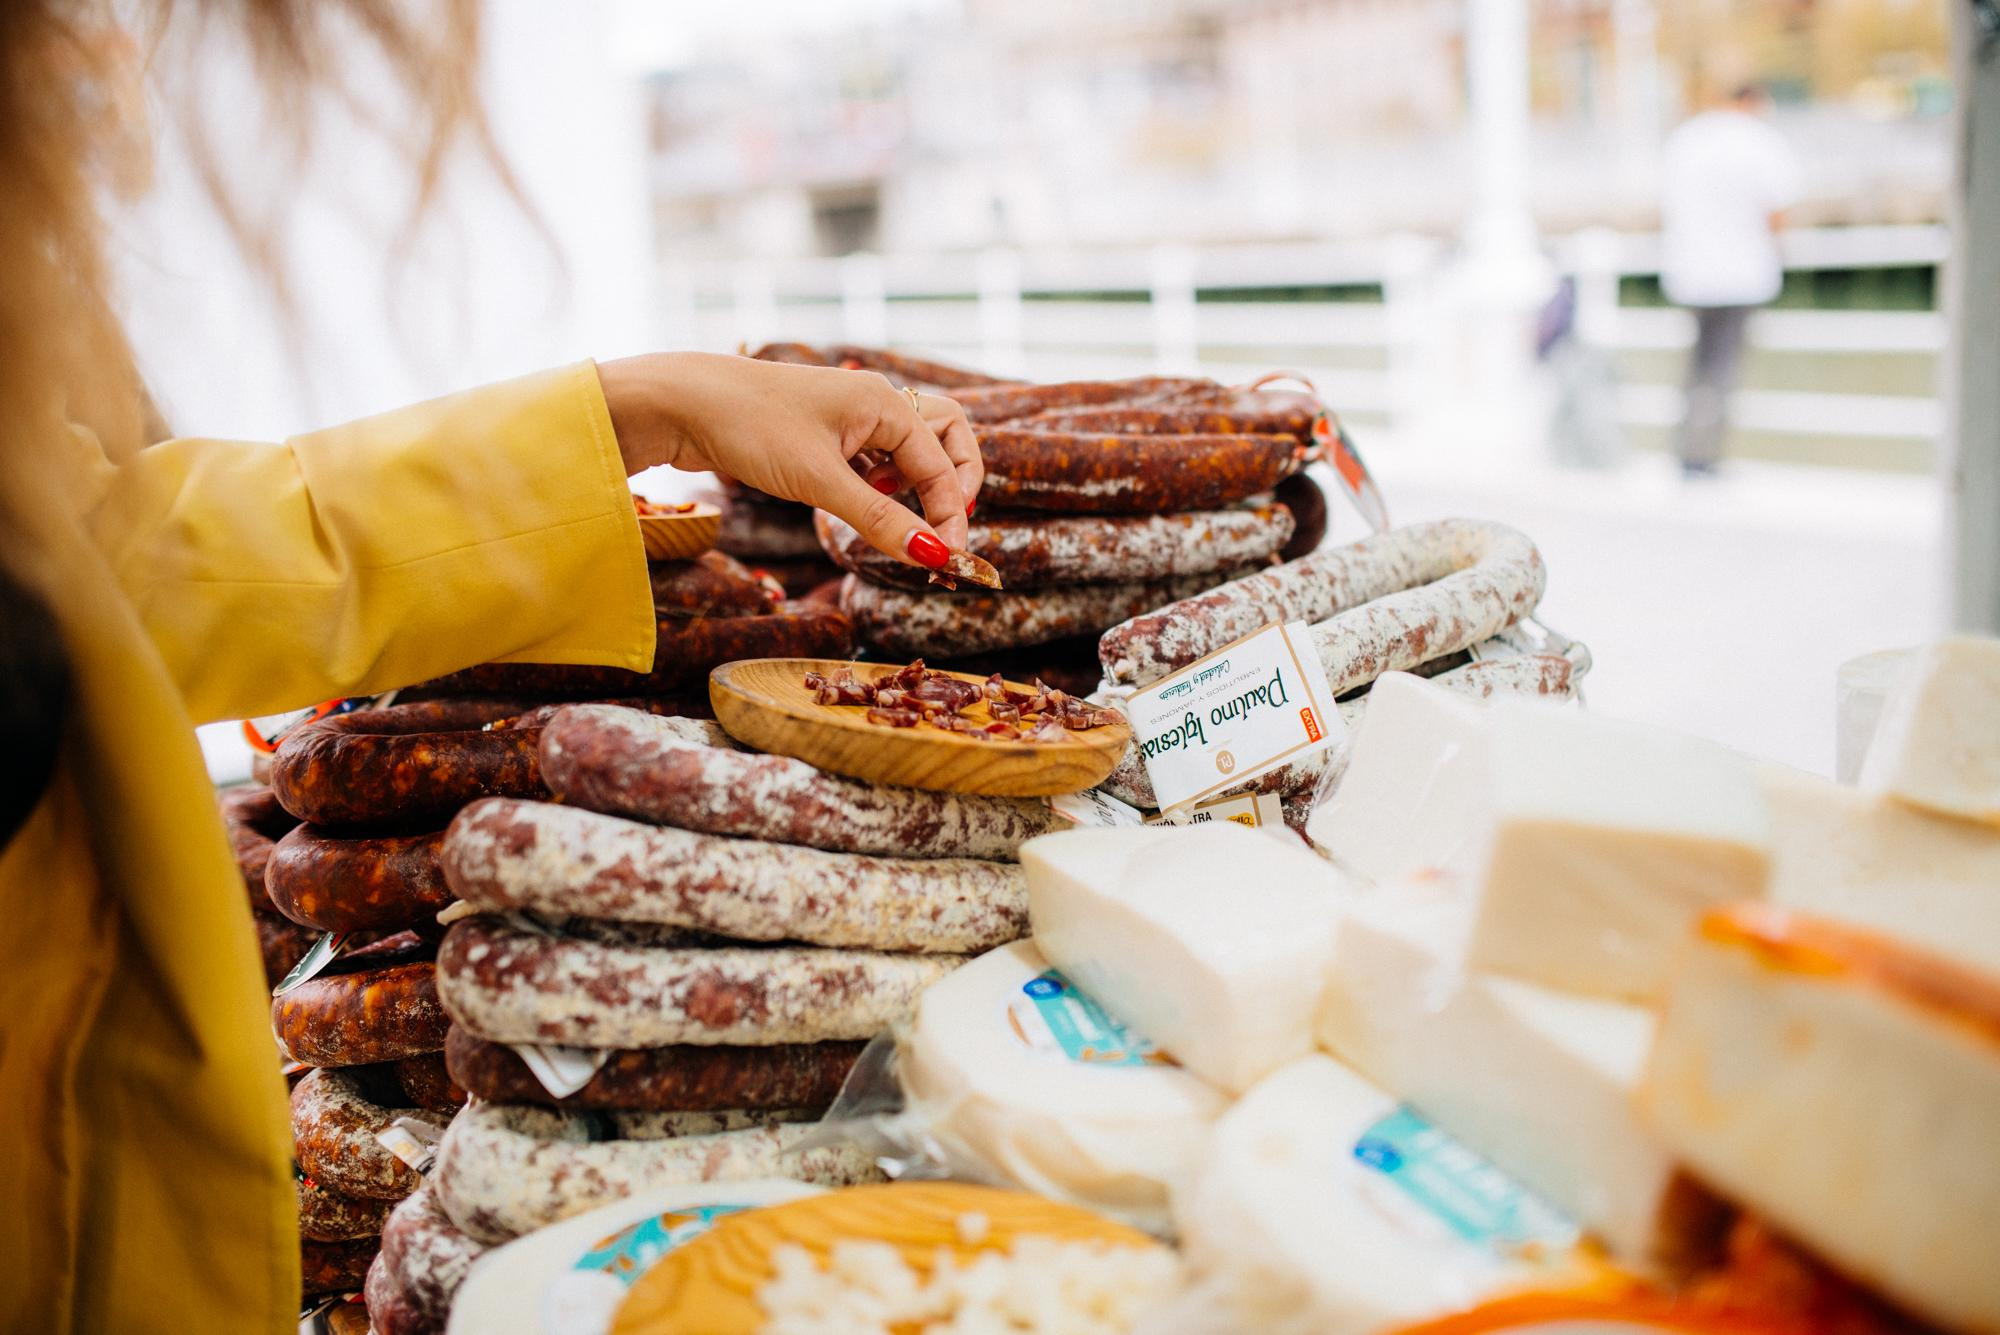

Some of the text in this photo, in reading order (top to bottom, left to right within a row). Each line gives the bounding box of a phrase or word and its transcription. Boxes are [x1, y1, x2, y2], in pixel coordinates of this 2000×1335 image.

[1200, 659, 1230, 686] Calidad
[1205, 666, 1262, 699] EMBUTIDOS
[1158, 680, 1196, 700] Tradición
[1210, 666, 1289, 726] Paulino
[1150, 699, 1196, 725] JAMONES
[1302, 708, 1319, 740] EXTRA
